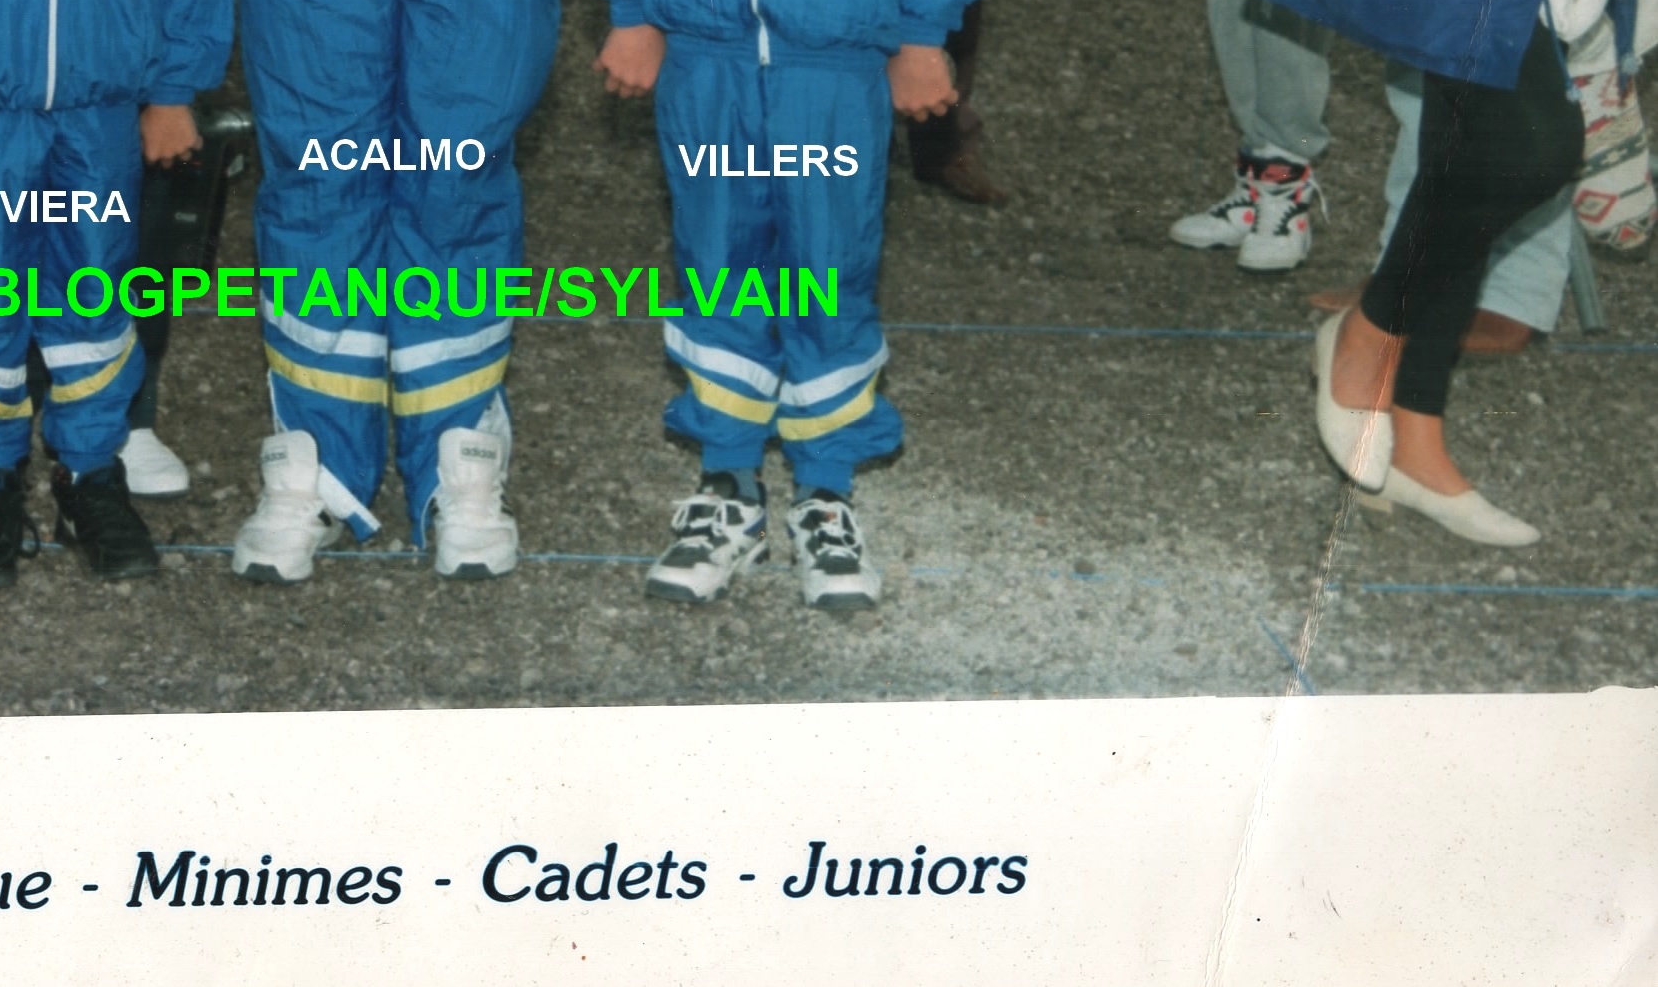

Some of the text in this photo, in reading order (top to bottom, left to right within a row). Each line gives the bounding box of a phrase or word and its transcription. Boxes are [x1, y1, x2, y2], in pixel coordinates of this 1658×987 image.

[461, 446, 497, 460] adidas
[126, 850, 403, 908] Minimes
[482, 842, 707, 903] Cadets
[783, 841, 1028, 899] Juniors
